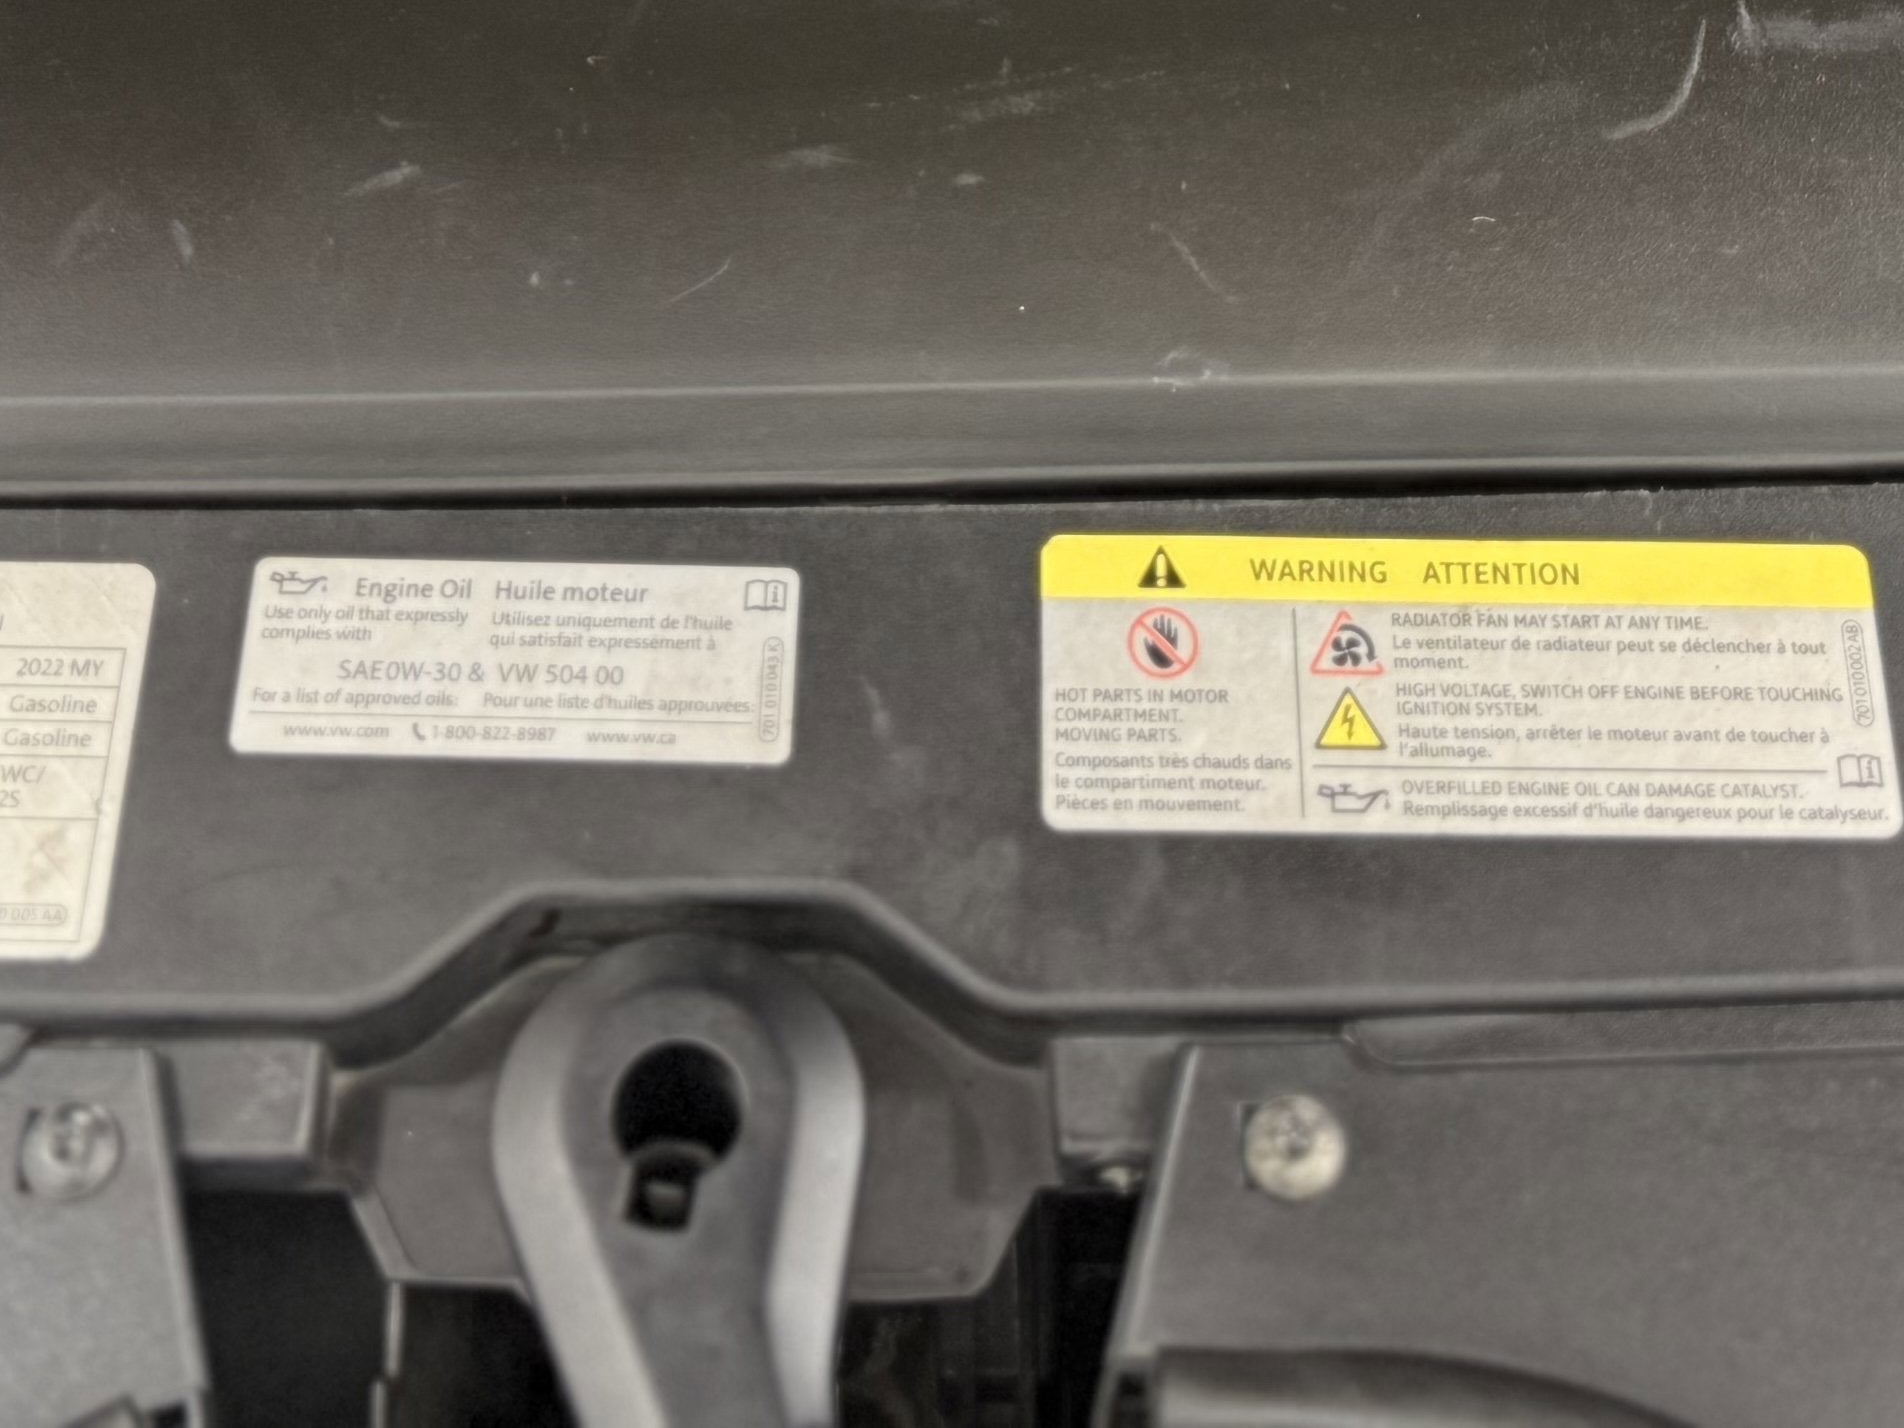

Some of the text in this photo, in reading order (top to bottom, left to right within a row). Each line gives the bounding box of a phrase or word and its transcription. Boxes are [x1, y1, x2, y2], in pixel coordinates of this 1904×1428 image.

[1249, 557, 1388, 584] WARNING
[1422, 561, 1581, 586] ATTENTION
[356, 578, 473, 604] Engine Oil
[496, 580, 648, 603] Huile moteur
[264, 604, 468, 626] Use only oil that expressly
[1391, 612, 1709, 631] RADIATOR FAN MAY START AT ANY TIME.
[261, 626, 372, 644] complies with
[1392, 636, 1826, 656] Le ventilateur de radiateur peut se déclencher à tout
[16, 657, 64, 677] 2022
[70, 659, 104, 677] MY
[1394, 656, 1470, 670] moment.
[468, 662, 485, 683] &
[499, 663, 539, 685] VW
[546, 664, 588, 685] 504
[595, 665, 624, 686] 00
[1054, 688, 1229, 704] HOT PARTS IN MOTOR
[1395, 683, 1844, 702] HIGH VOLTAGE, SWITCH OFF ENGINE BEFORE TOUCHING
[8, 693, 97, 715] Gasoline
[1396, 701, 1543, 717] IGNITION SYSTEM.
[1054, 707, 1184, 724] COMPARTMENT.
[3, 728, 92, 749] Gasoline
[283, 724, 390, 739] www.vw.com
[586, 730, 677, 745] www.vw.ca
[1055, 727, 1182, 743] MOVING PARTS.
[1402, 780, 1804, 799] OVERFILLED ENGINE OIL CAN DAMAGE CATALYST.
